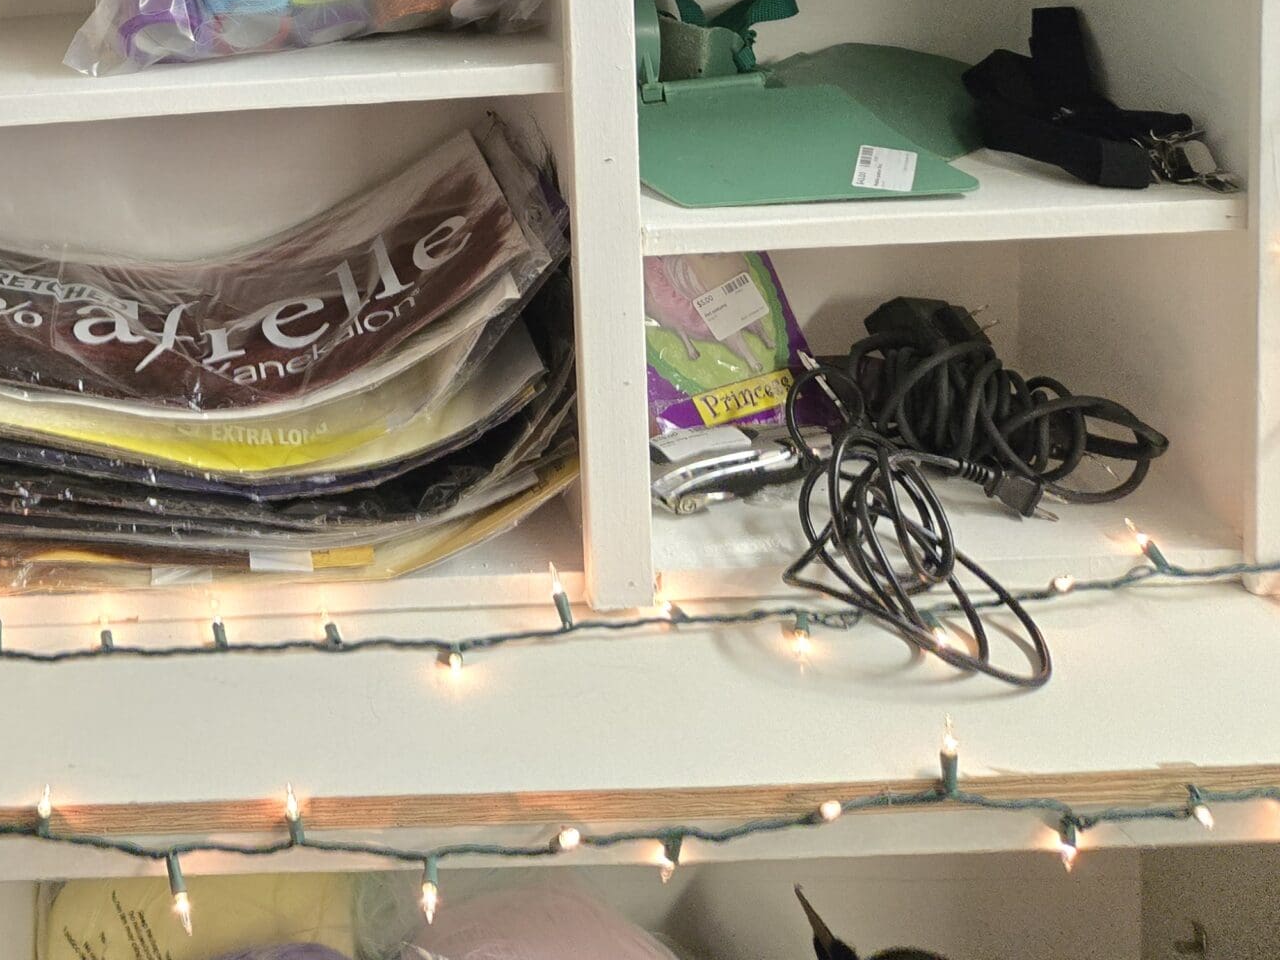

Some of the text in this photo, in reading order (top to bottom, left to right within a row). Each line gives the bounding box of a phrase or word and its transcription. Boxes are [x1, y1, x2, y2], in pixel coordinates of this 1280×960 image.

[73, 215, 472, 373] afrelle
[696, 294, 714, 308] $5.00
[699, 374, 793, 418] Princess
[211, 423, 274, 446] EXTRA
